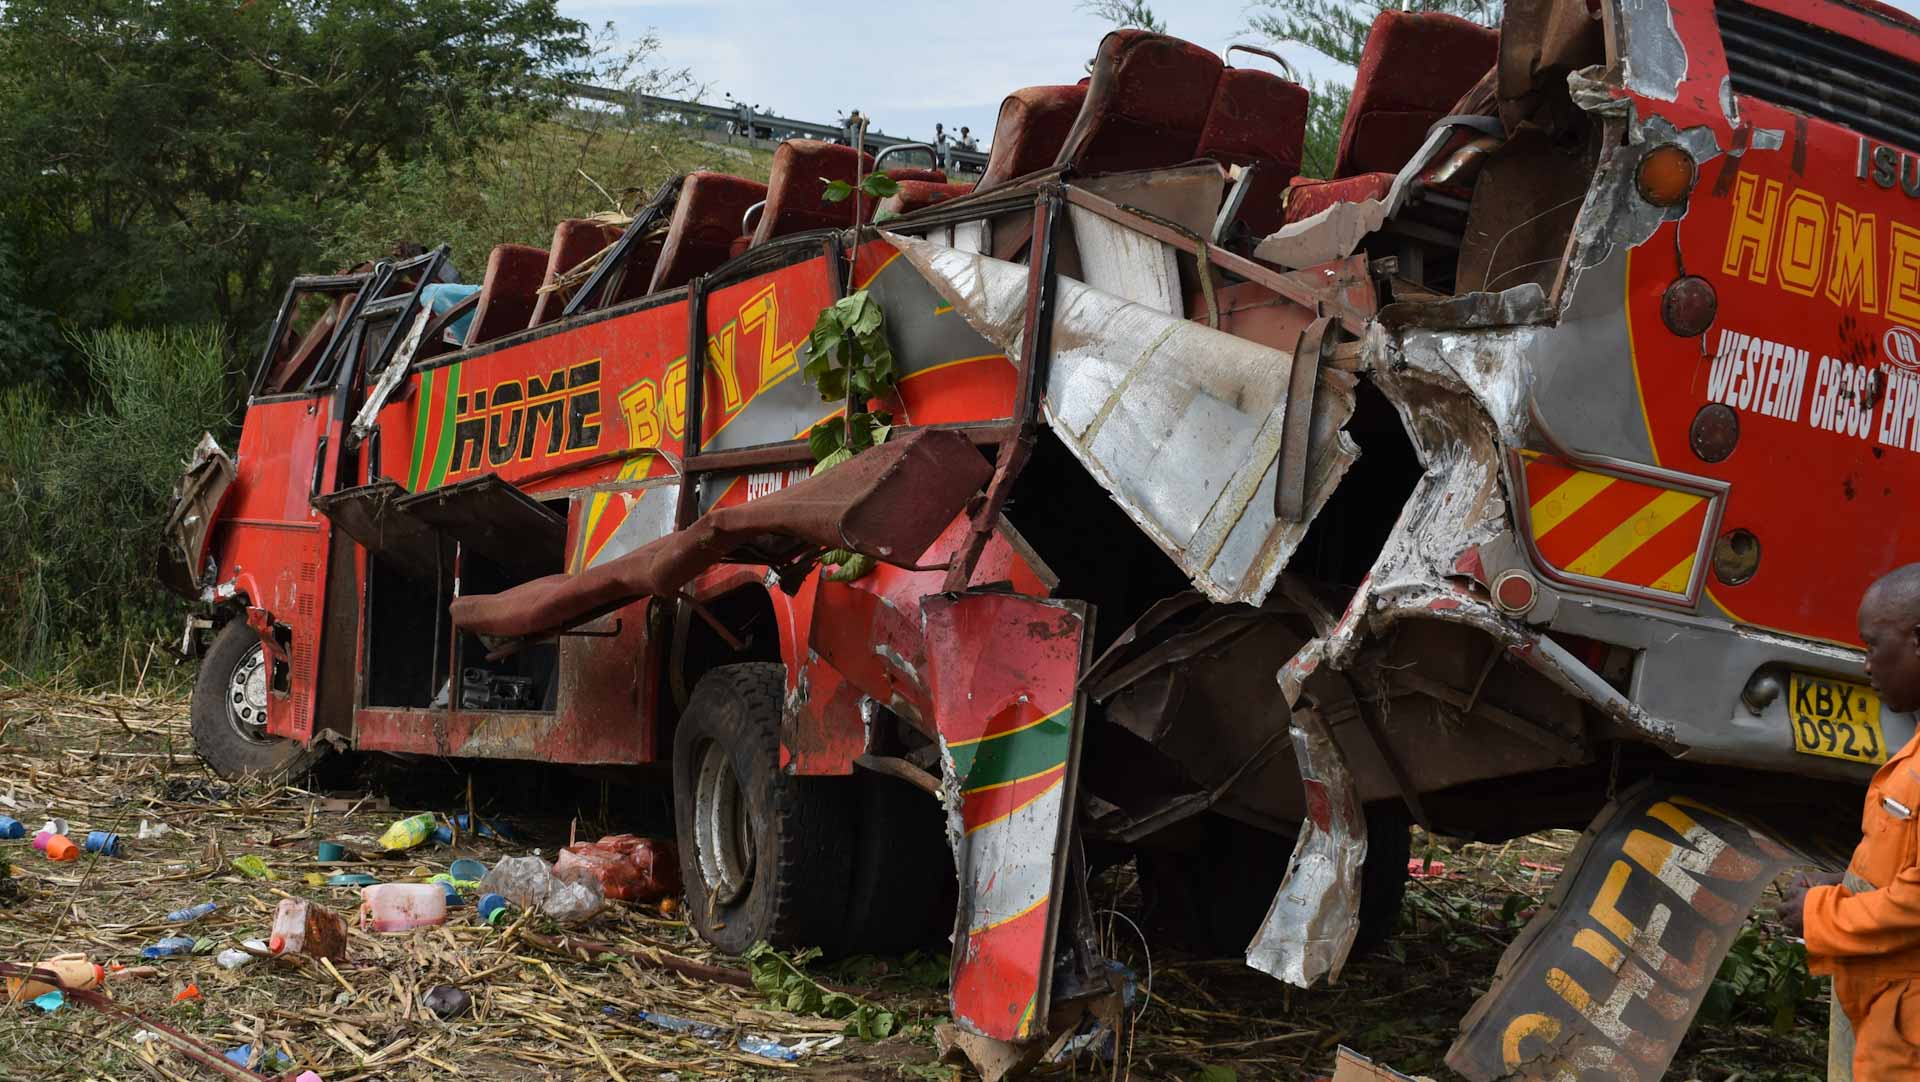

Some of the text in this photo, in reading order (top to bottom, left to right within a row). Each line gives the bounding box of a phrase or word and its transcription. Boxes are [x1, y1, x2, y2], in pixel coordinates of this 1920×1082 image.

[1722, 171, 1920, 328] HOME
[448, 358, 601, 475] HOME
[1707, 329, 1810, 422] WESTERN
[1810, 355, 1879, 440] CROSS
[1796, 677, 1854, 721] KBX
[1799, 715, 1880, 758] 092J
